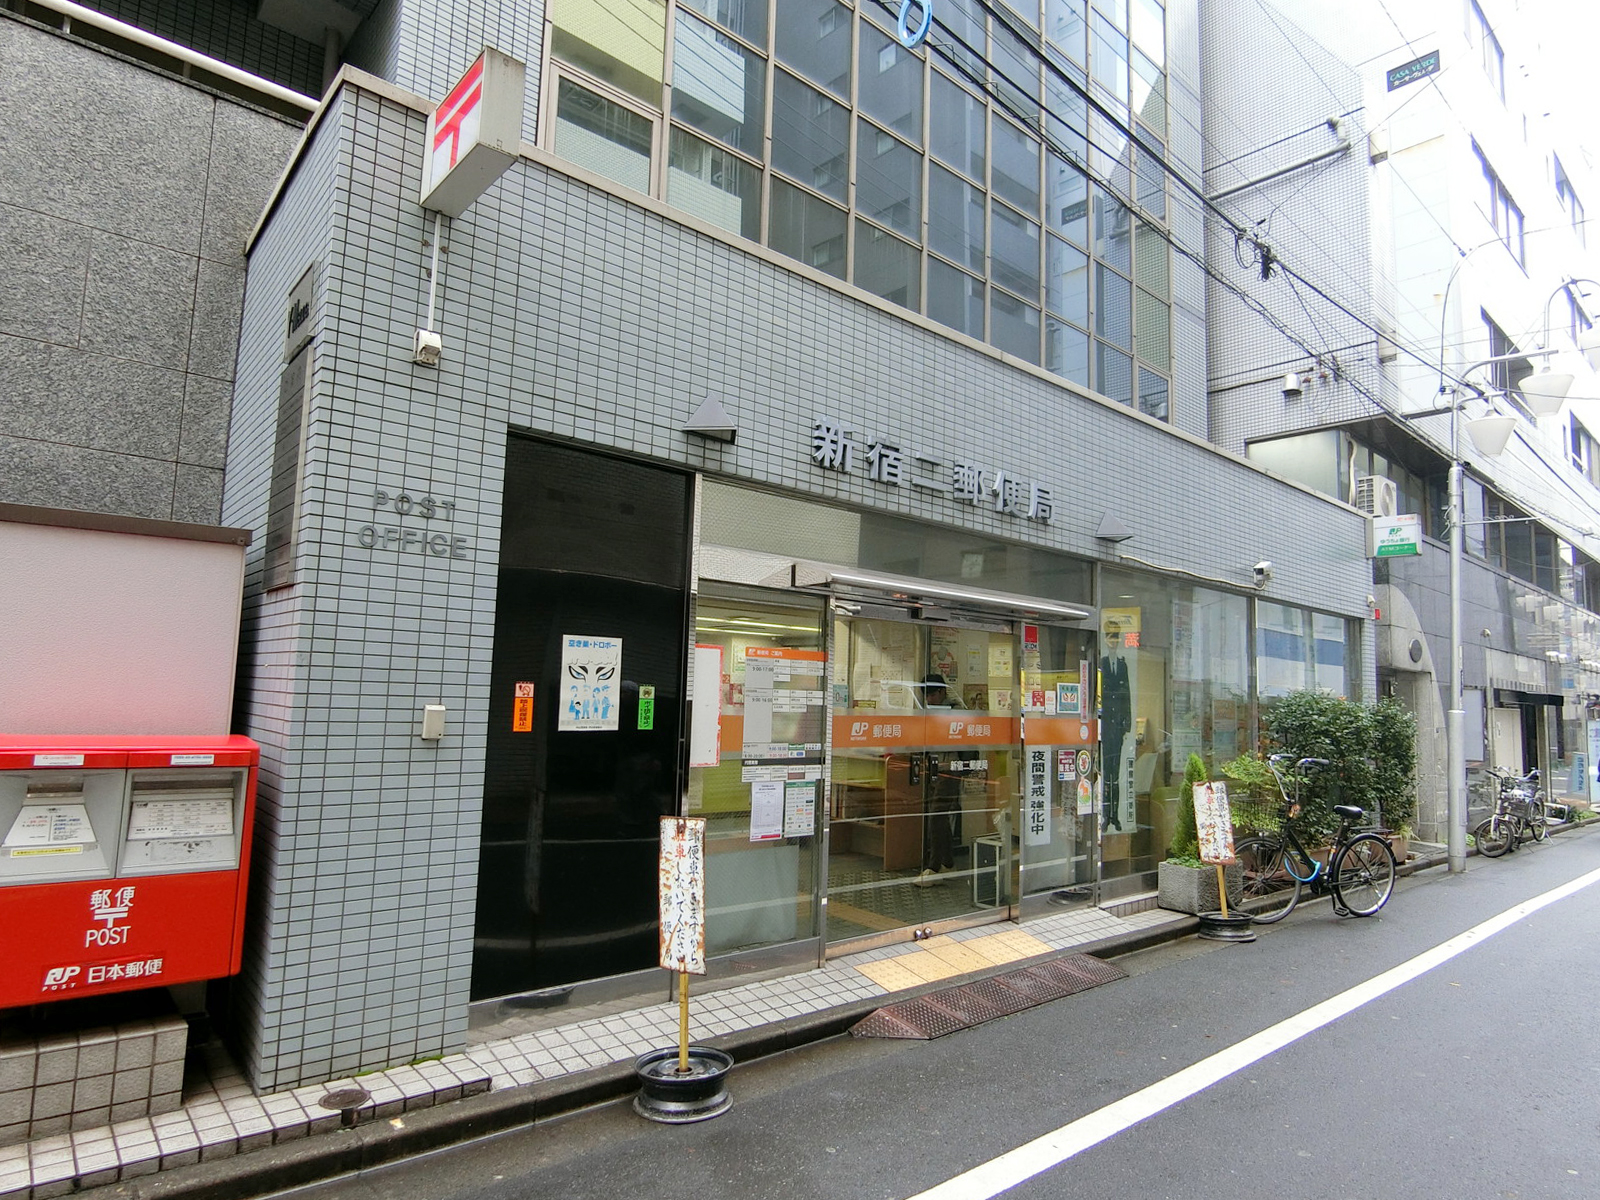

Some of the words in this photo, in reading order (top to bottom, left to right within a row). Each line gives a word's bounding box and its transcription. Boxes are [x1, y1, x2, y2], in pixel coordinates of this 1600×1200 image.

[1390, 69, 1410, 81] CASA
[811, 414, 1056, 526] 新宿二郵便局
[372, 488, 457, 521] POST
[358, 524, 467, 558] OFFICE
[872, 724, 902, 738] 郵便局
[967, 724, 991, 737] 郵便局
[90, 886, 136, 911] 郵便
[85, 925, 132, 948] POST
[87, 958, 163, 984] 日本郵便
[41, 982, 77, 992] POST
